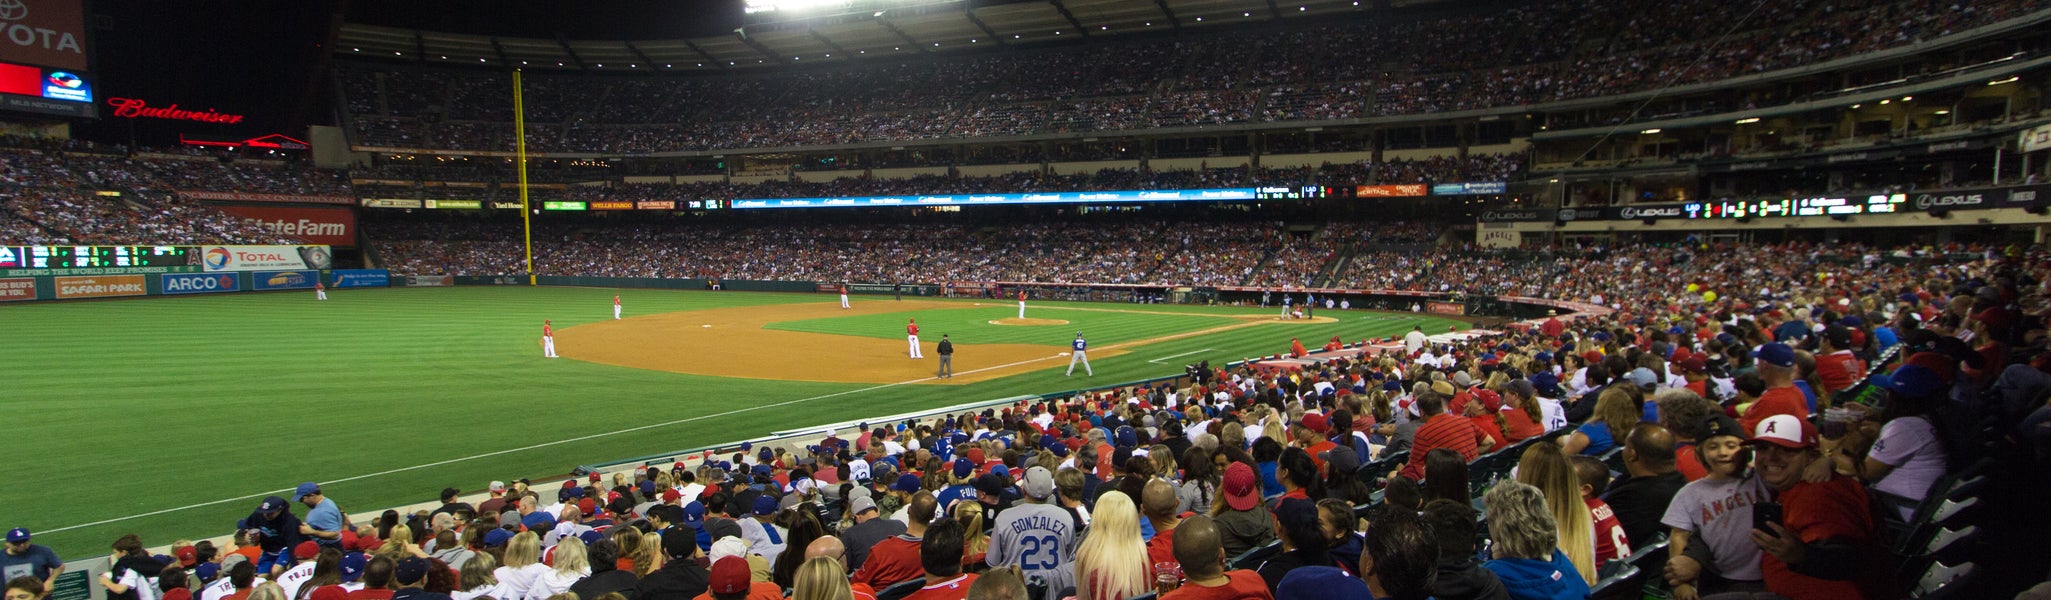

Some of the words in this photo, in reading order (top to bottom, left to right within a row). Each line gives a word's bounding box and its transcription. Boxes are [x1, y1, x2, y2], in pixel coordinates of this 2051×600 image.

[32, 101, 74, 110] NETWORK
[106, 97, 243, 124] Budweiser
[1934, 194, 1983, 206] LEXUS
[1636, 208, 1681, 216] LEXUS
[1685, 203, 1701, 211] LAD
[1484, 231, 1513, 241] ANGELS
[235, 251, 286, 262] TOTAL
[8, 269, 50, 277] HELPING
[52, 268, 69, 276] THE
[10, 281, 34, 289] BUD'S
[61, 285, 107, 295] SAFARI
[109, 283, 142, 292] PARK
[167, 276, 217, 291] ARCO
[1765, 420, 1777, 433] A
[1011, 515, 1066, 537] GONZALEZ
[1020, 535, 1059, 570] 23
